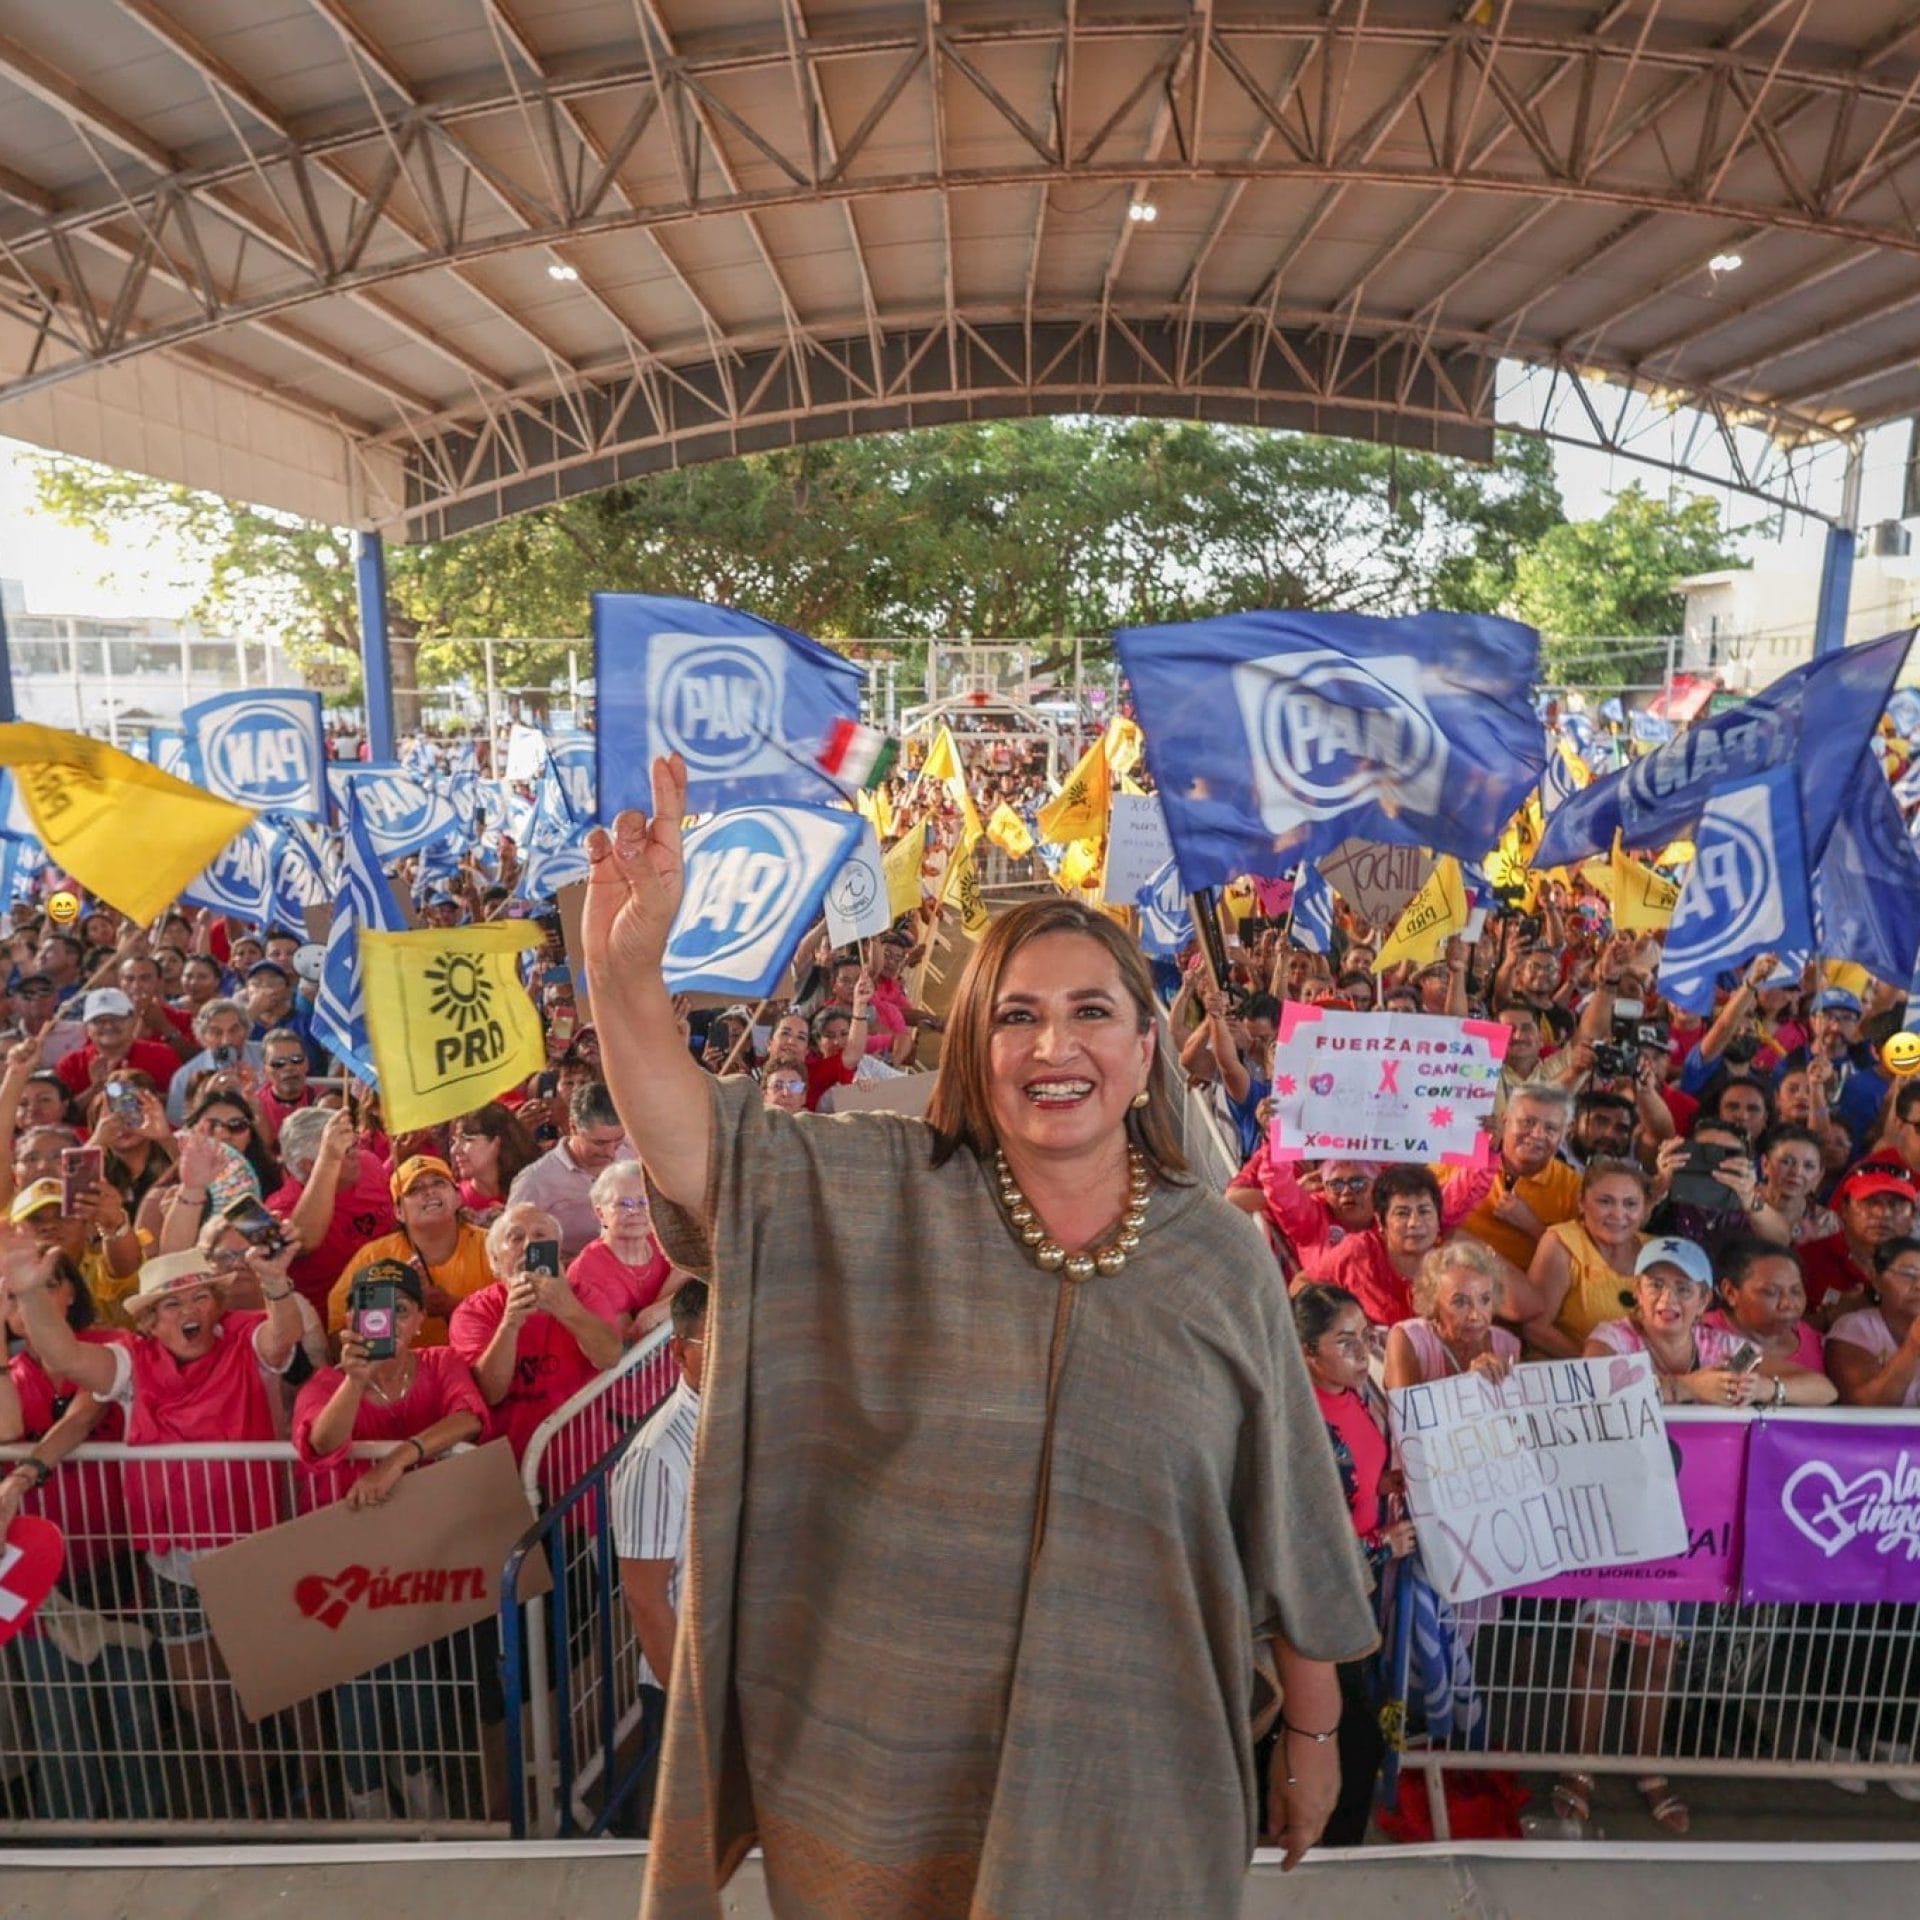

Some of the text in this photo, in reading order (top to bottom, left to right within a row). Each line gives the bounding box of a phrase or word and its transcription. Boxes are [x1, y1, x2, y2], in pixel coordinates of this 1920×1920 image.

[679, 674, 764, 741] PAN
[1285, 691, 1409, 775] PAN
[1549, 1361, 1596, 1404] UN
[1437, 1483, 1639, 1594] XOCHITL
